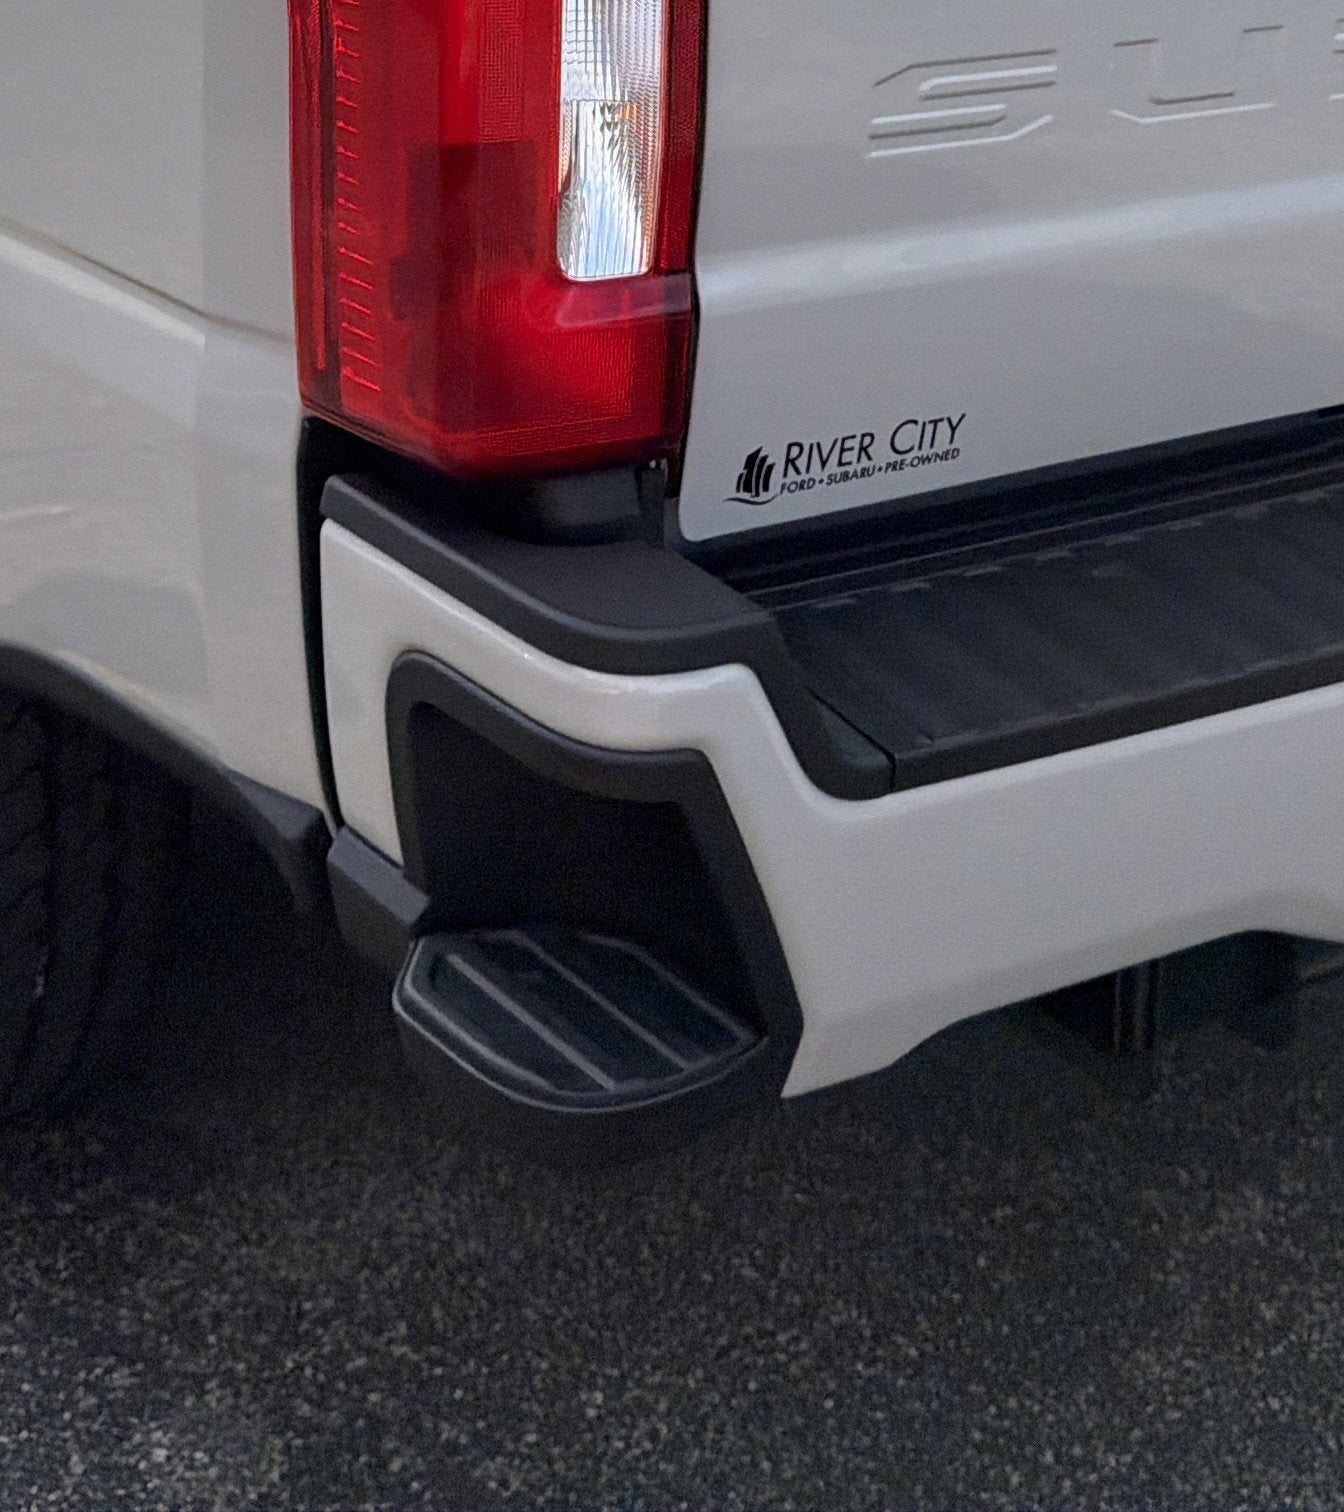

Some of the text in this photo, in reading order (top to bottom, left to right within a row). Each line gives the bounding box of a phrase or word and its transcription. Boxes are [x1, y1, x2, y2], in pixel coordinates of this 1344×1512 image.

[779, 447, 961, 496] FORD SUBARU PRE-OWNED
[782, 412, 967, 479] RIVER CITY
